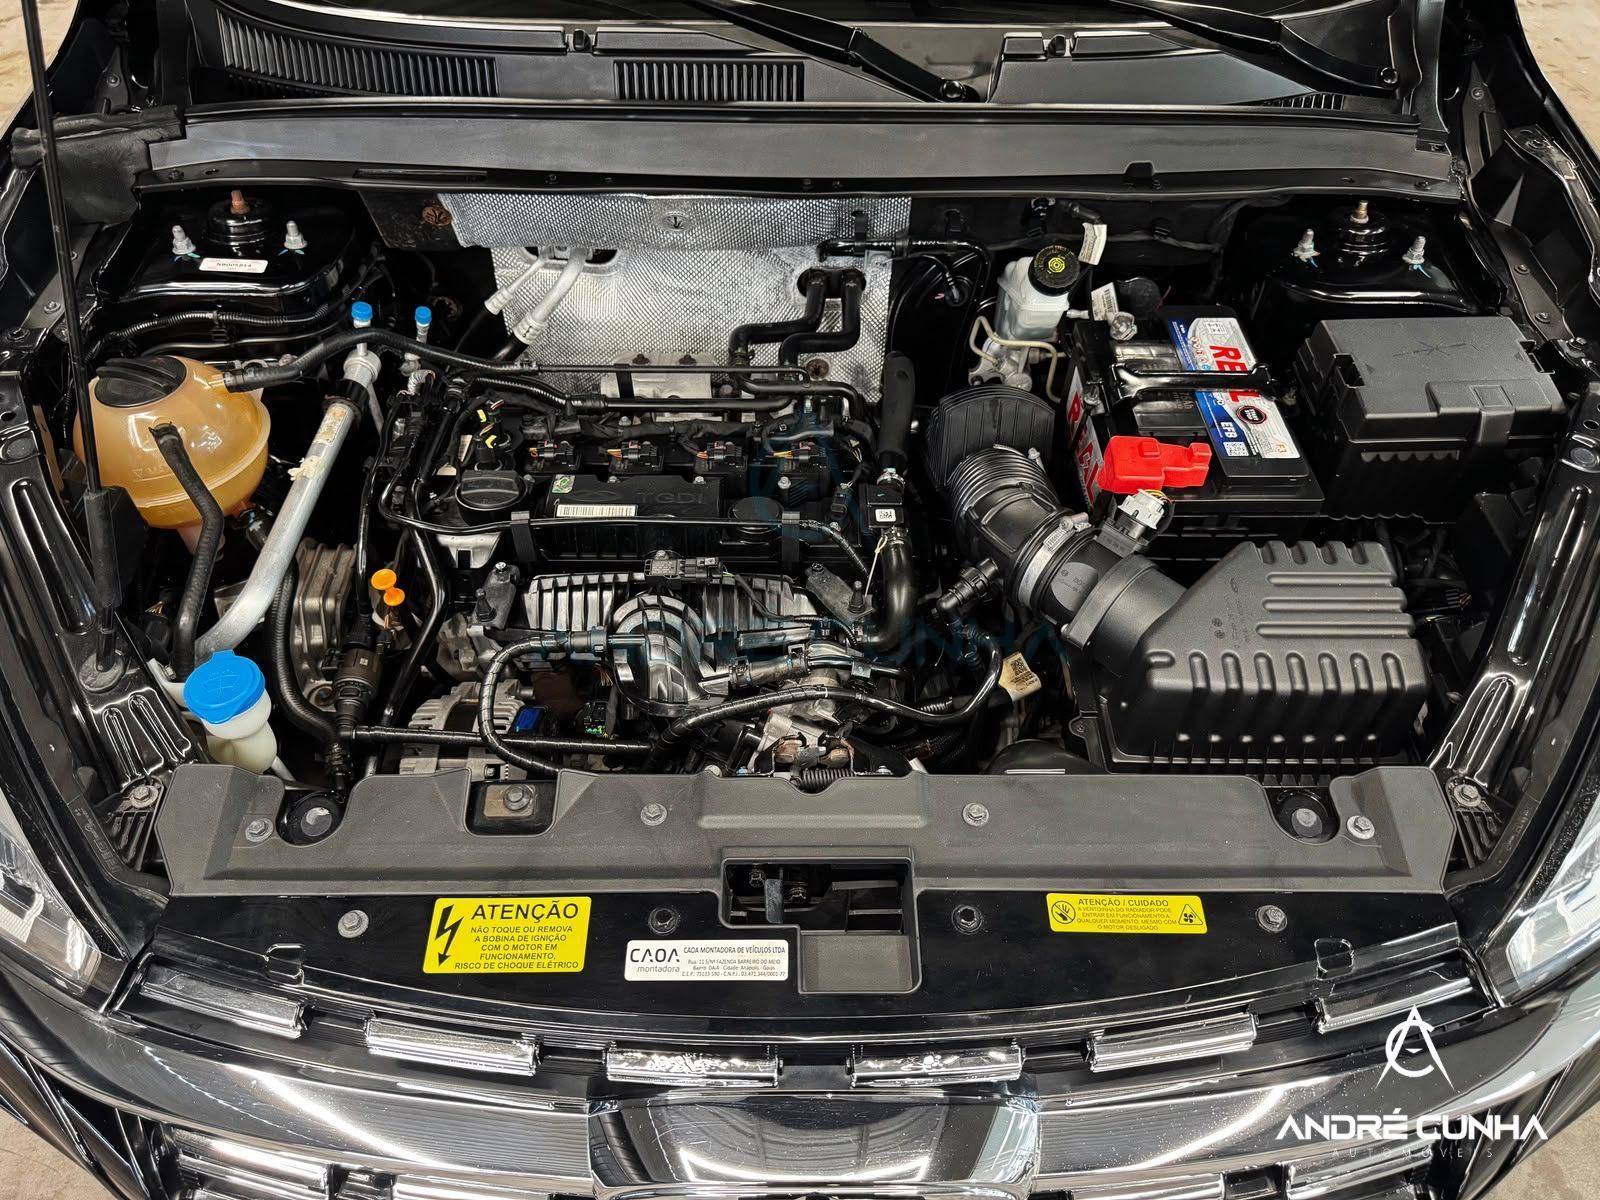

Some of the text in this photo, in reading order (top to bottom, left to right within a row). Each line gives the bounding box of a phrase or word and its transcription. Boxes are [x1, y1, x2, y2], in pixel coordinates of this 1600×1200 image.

[1208, 345, 1261, 403] REL
[1220, 421, 1238, 439] EFB
[1078, 897, 1121, 908] ATENÇÃO
[1127, 899, 1169, 907] CUIDADO
[471, 899, 579, 924] ATENÇÃO
[470, 925, 490, 934] NÃO
[492, 926, 520, 934] TOQUE
[537, 925, 573, 933] REMOVA
[530, 933, 567, 944] IGNIÇÃO
[683, 944, 786, 954] CAOA MONTADORA DE VEÍCULOS LTDA
[630, 948, 680, 962] CAOA
[497, 961, 534, 969] CHOQUE
[536, 959, 579, 969] ELÉTRICO
[637, 965, 680, 973] montadora
